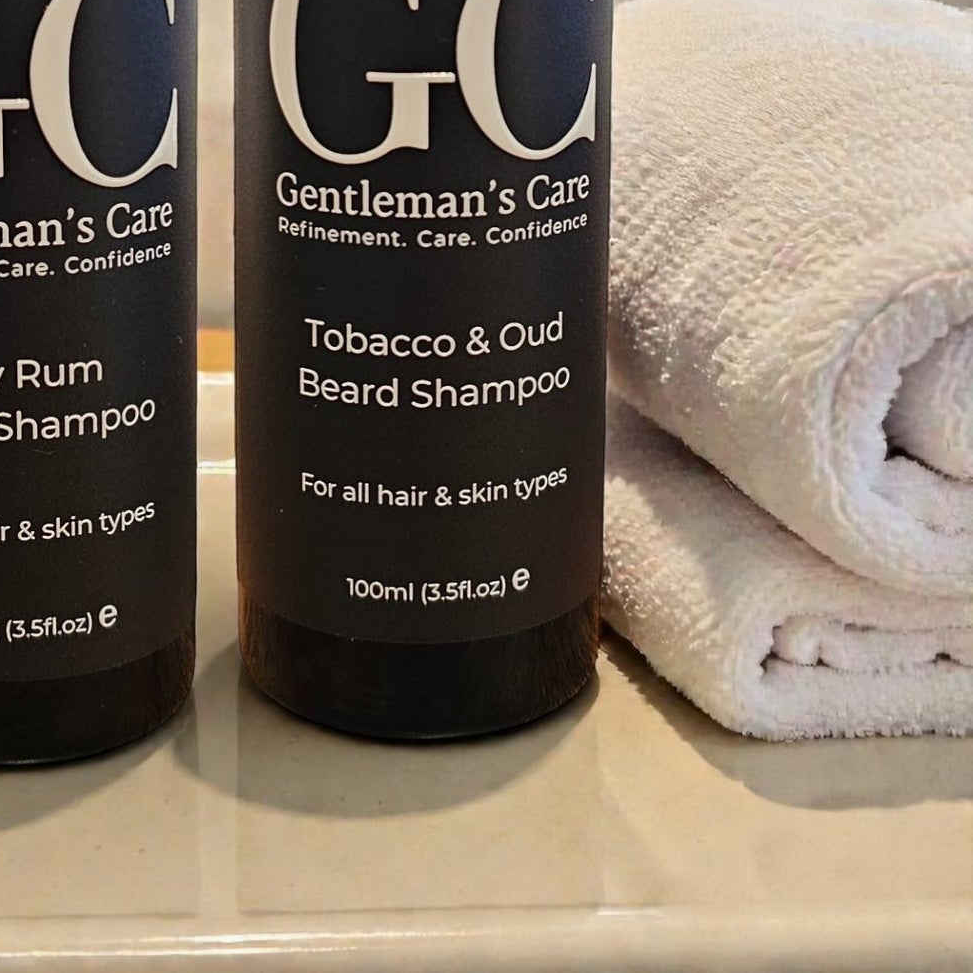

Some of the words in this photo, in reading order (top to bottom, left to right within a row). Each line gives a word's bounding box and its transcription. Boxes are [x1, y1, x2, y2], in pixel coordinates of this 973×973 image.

[277, 172, 515, 221] Gentleman's
[527, 175, 589, 209] Care
[107, 202, 172, 238] Care
[279, 215, 407, 247] Refinement.
[417, 230, 476, 247] Care.
[483, 210, 587, 244] Confidence
[62, 239, 171, 274] Confidence
[305, 319, 456, 357] Tobacco
[466, 327, 490, 355] &
[500, 311, 563, 350] Oud
[17, 360, 102, 388] Rum
[300, 368, 398, 407] Beard
[411, 367, 570, 408] Shampoo
[302, 473, 337, 497] For
[343, 482, 369, 503] all
[378, 484, 428, 506] hair
[435, 486, 452, 506] &
[459, 481, 507, 505] skin
[514, 468, 567, 500] types
[18, 521, 35, 541] &
[42, 516, 92, 539] skin
[99, 503, 154, 534] types
[346, 578, 413, 601] 100ml
[422, 576, 506, 605] (3.5fl.oz)
[6, 612, 92, 642] (3.5fl.oz)
